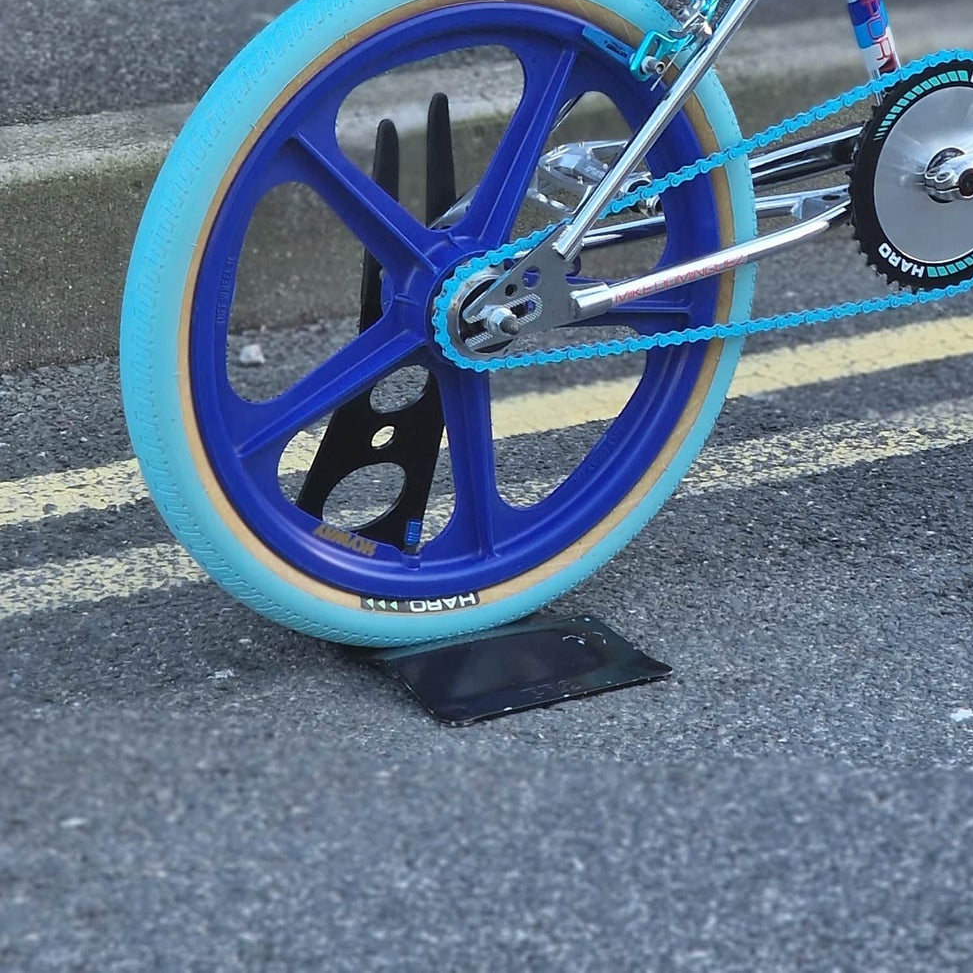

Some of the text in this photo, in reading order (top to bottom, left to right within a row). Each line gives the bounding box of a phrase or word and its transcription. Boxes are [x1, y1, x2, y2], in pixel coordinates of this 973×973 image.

[878, 243, 925, 277] HARO
[614, 284, 651, 304] MIKE
[409, 592, 477, 613] HARO
